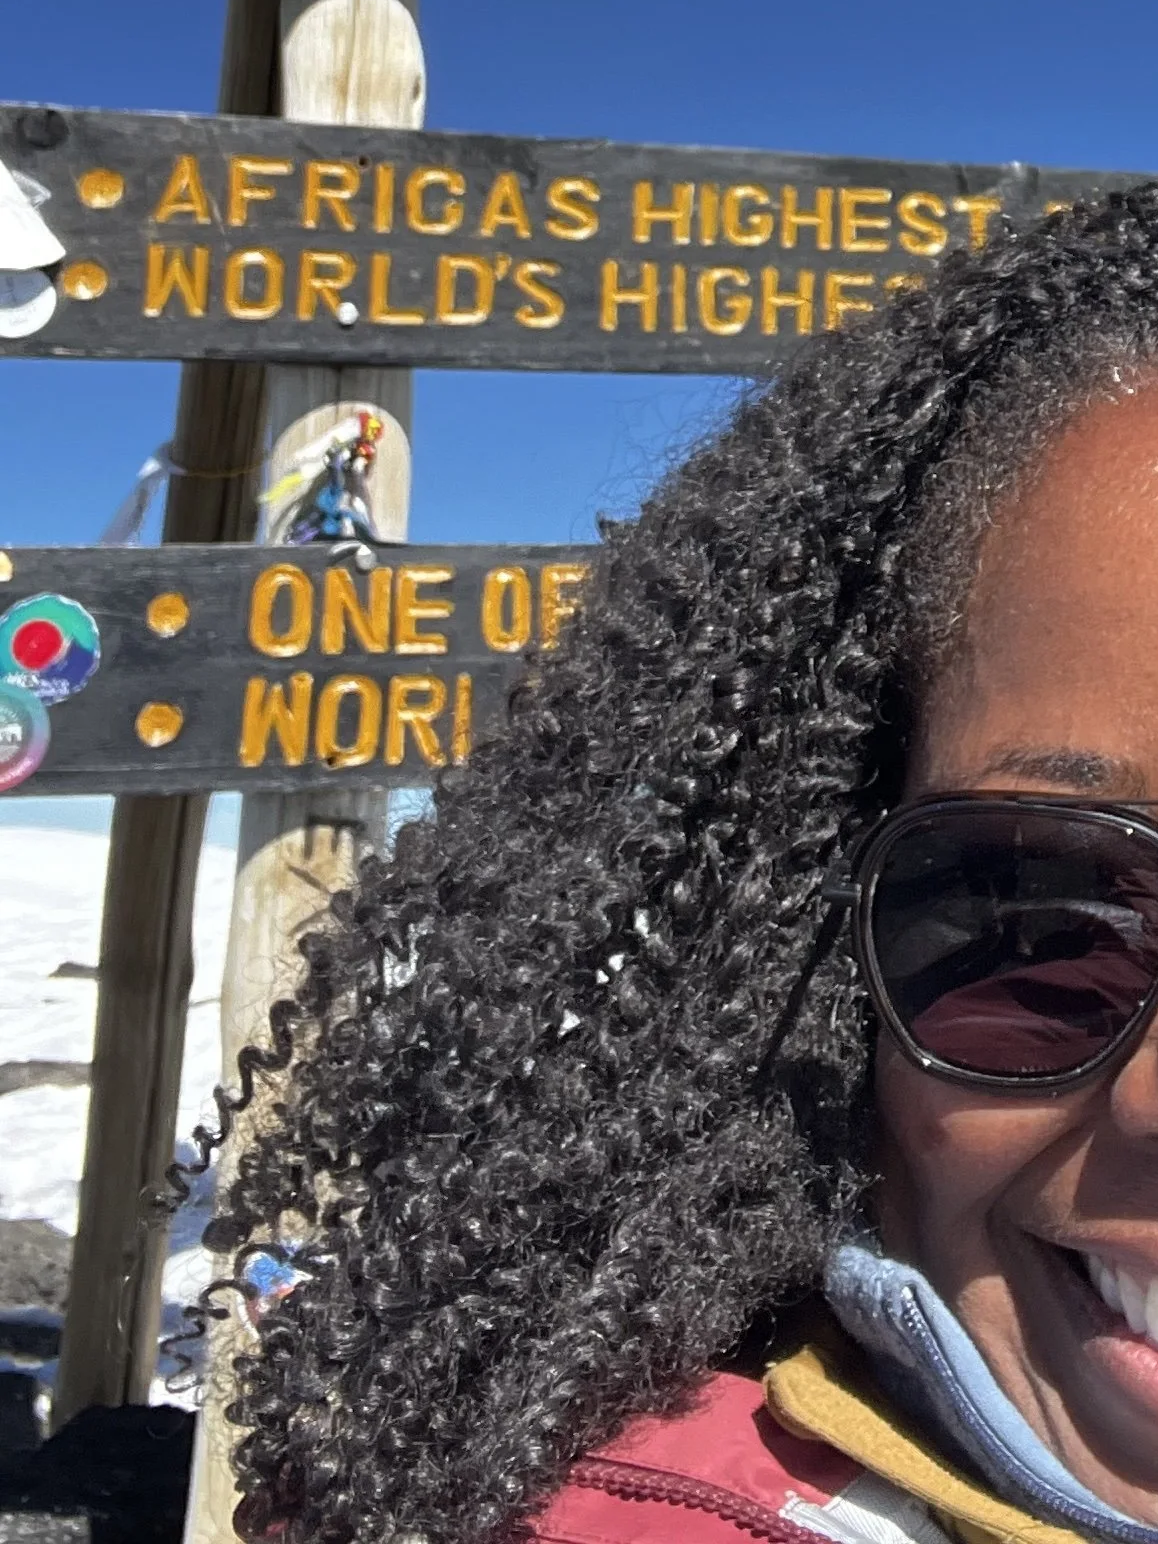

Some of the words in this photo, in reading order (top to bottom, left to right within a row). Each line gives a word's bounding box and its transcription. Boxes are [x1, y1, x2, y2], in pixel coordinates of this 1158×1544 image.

[630, 178, 1006, 257] HIGHEST
[142, 240, 567, 330] WORLD'S
[598, 258, 927, 337] HIGHE
[247, 561, 456, 660] ONE
[480, 562, 590, 654] OF
